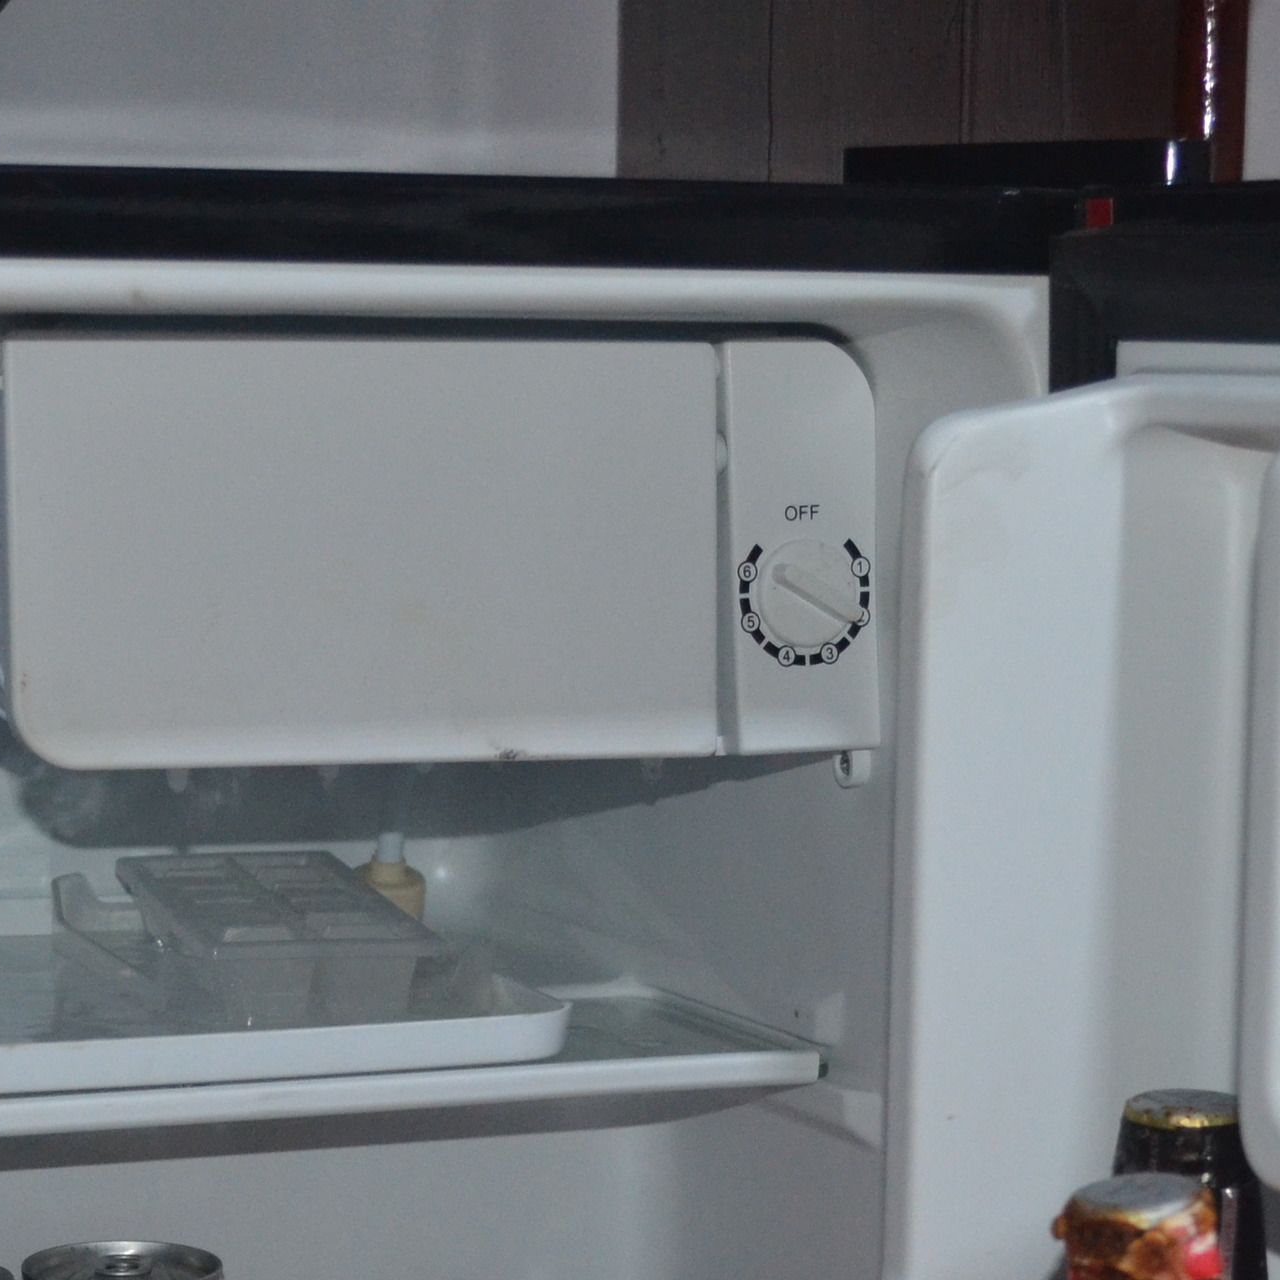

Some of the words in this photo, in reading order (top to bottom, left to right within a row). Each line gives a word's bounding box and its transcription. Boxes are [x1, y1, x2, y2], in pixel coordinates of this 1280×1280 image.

[784, 505, 820, 521] OFF
[743, 567, 752, 579] 6
[747, 616, 755, 628] 5
[782, 651, 791, 663] 4
[825, 647, 834, 659] 3
